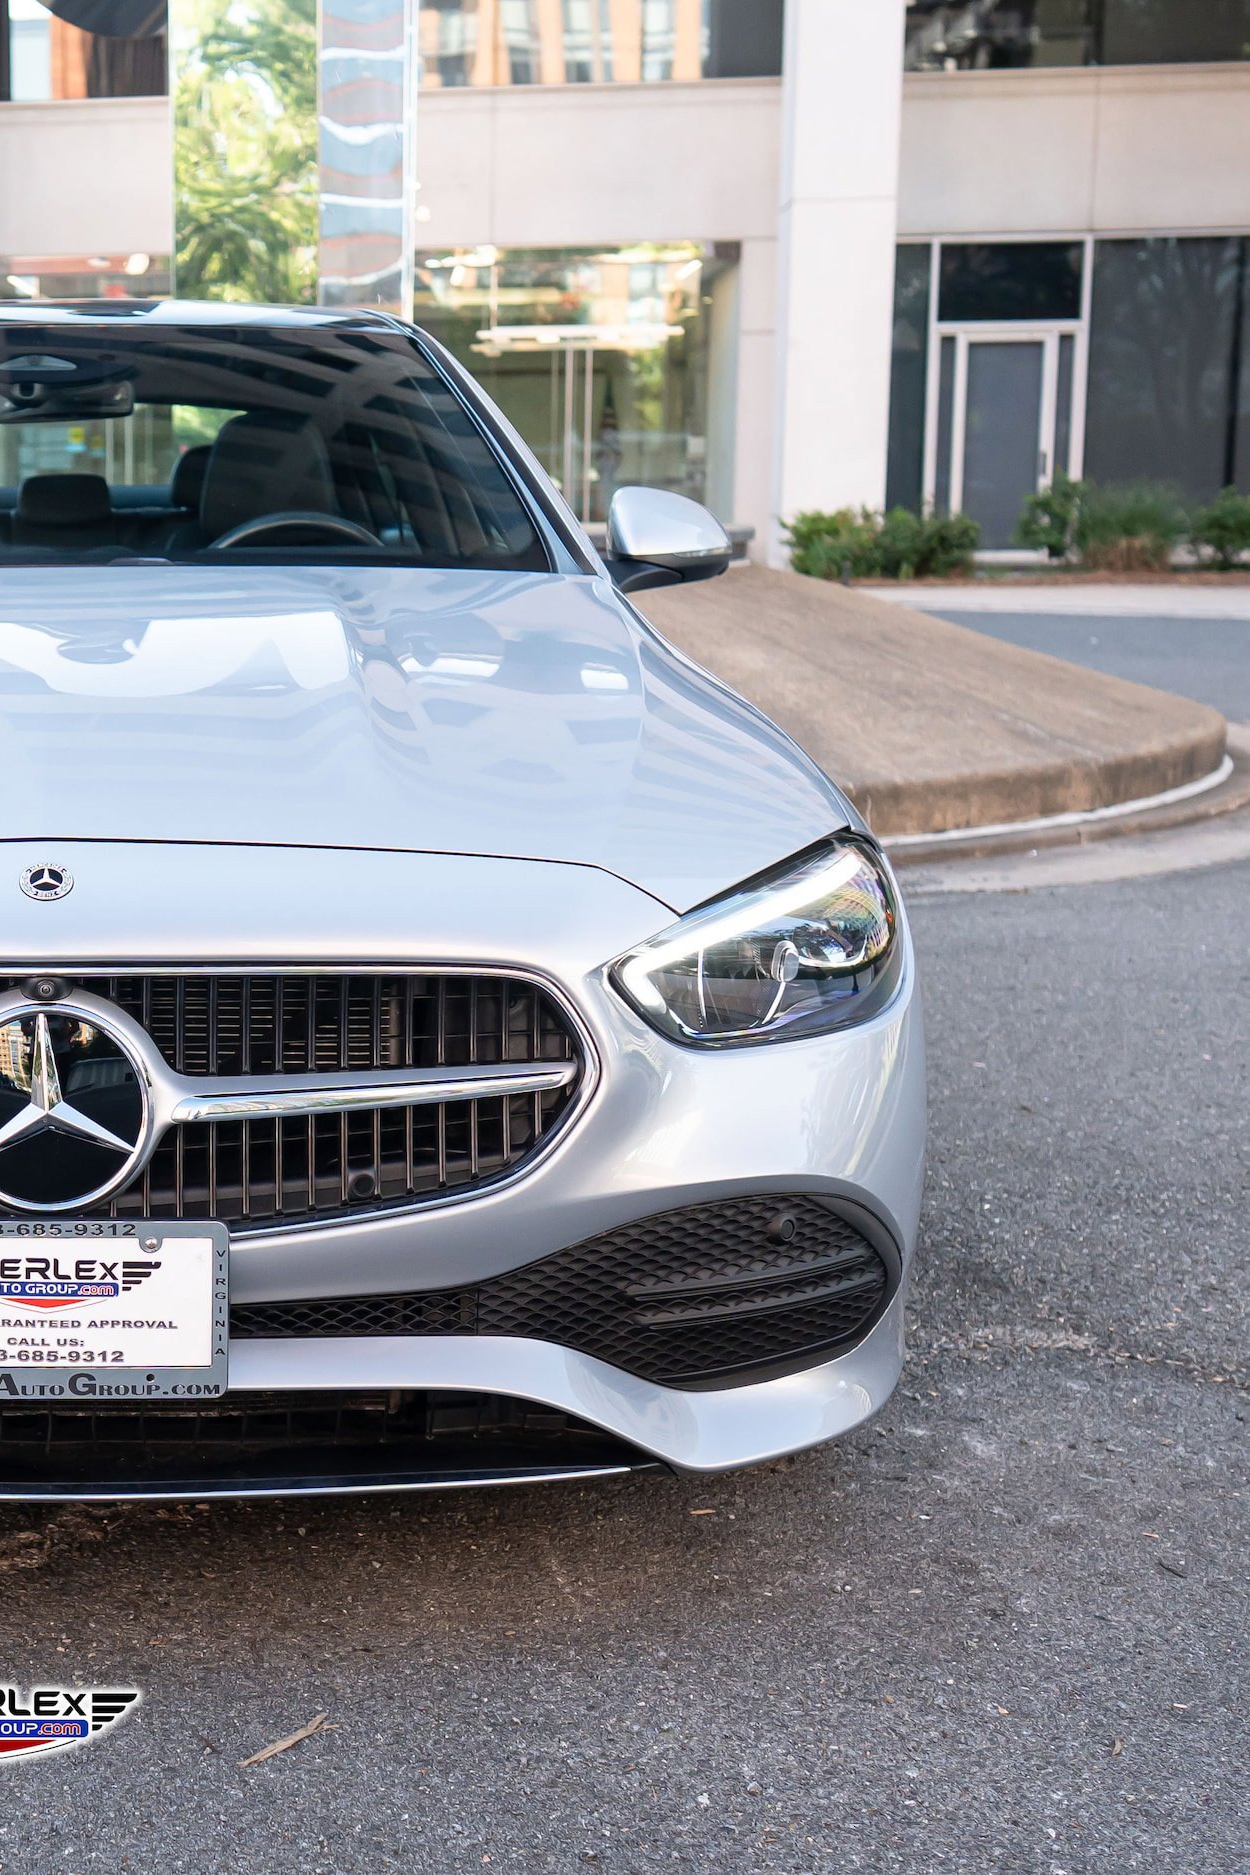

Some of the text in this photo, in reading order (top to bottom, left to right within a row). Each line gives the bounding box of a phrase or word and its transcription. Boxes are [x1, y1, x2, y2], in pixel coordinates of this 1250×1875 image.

[214, 1249, 226, 1356] VIRGINIA
[88, 1319, 178, 1330] APPROVAL
[7, 1337, 85, 1347] CALL US:
